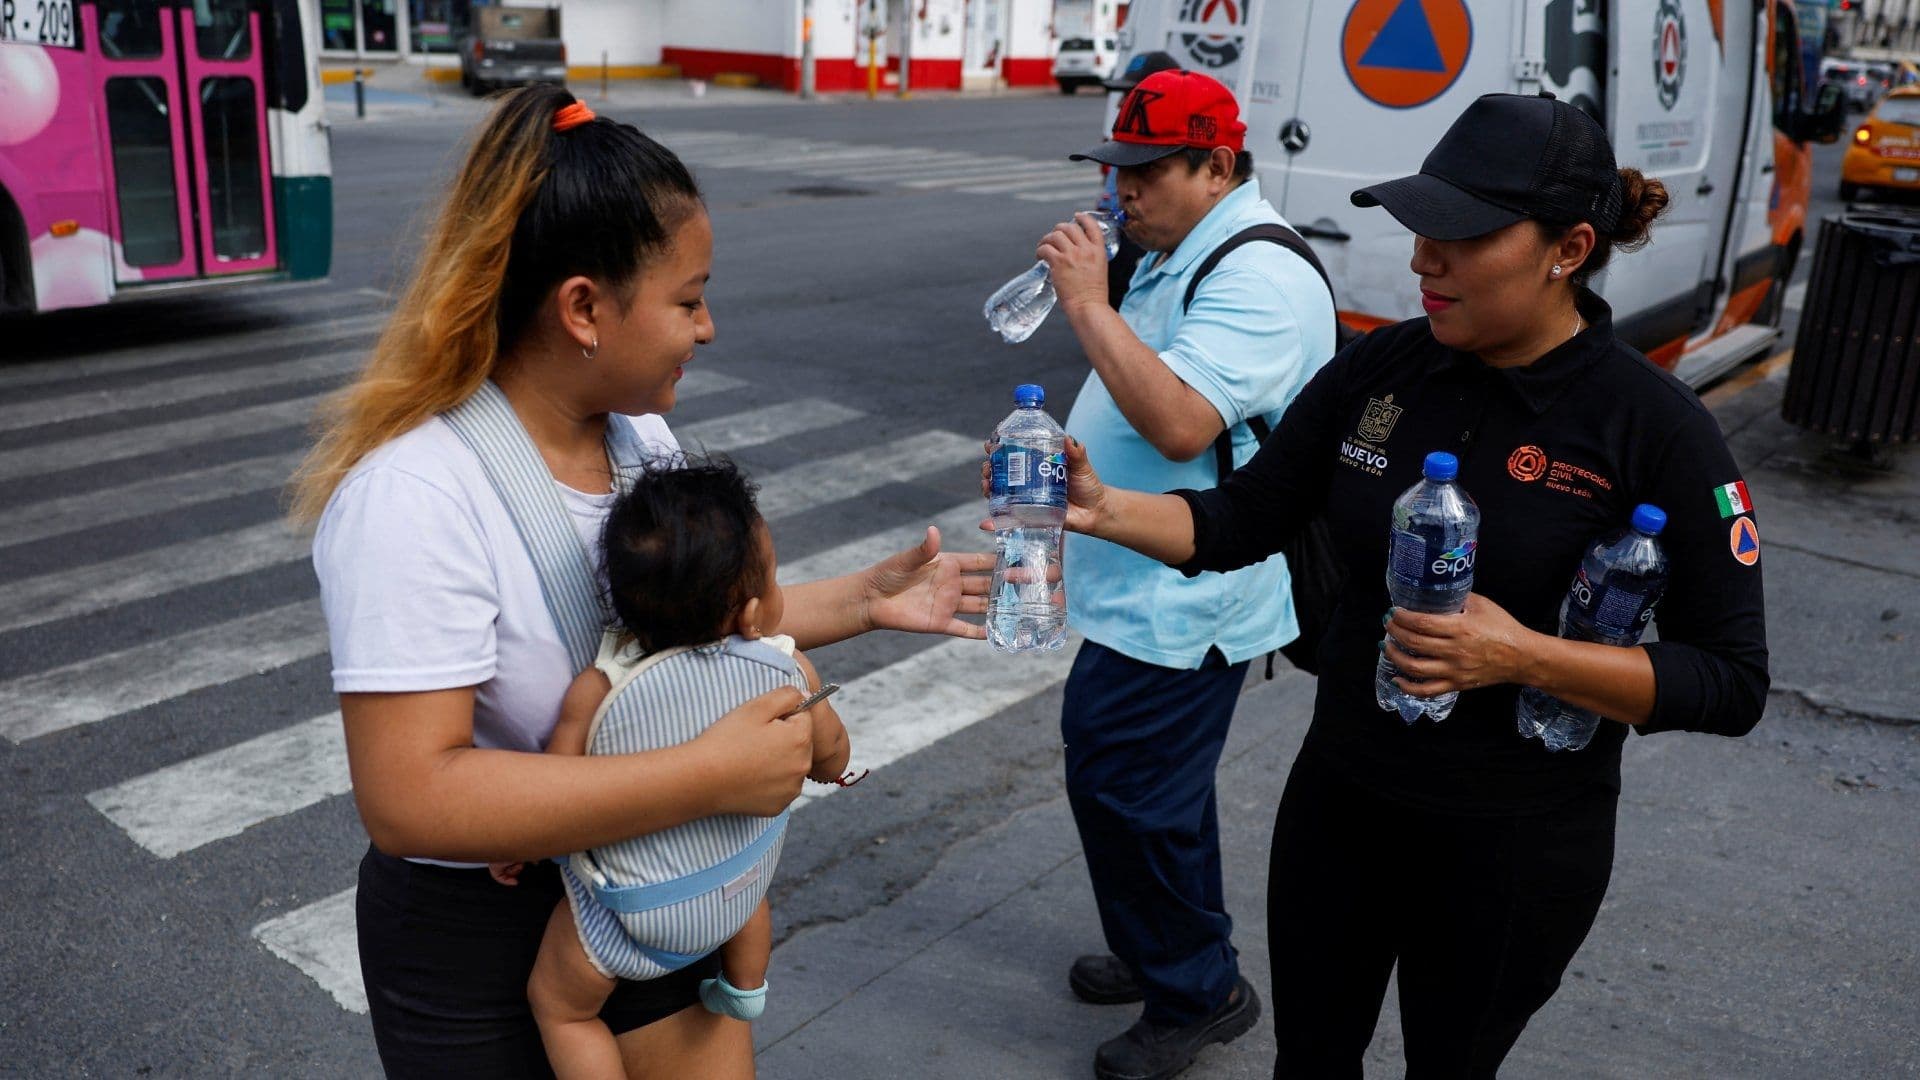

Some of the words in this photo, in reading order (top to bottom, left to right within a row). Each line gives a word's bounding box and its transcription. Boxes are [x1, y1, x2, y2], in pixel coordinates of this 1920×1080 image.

[37, 0, 70, 42] 209
[1121, 89, 1164, 136] K
[1341, 441, 1388, 469] NUEVO
[1550, 469, 1574, 481] CIVIL
